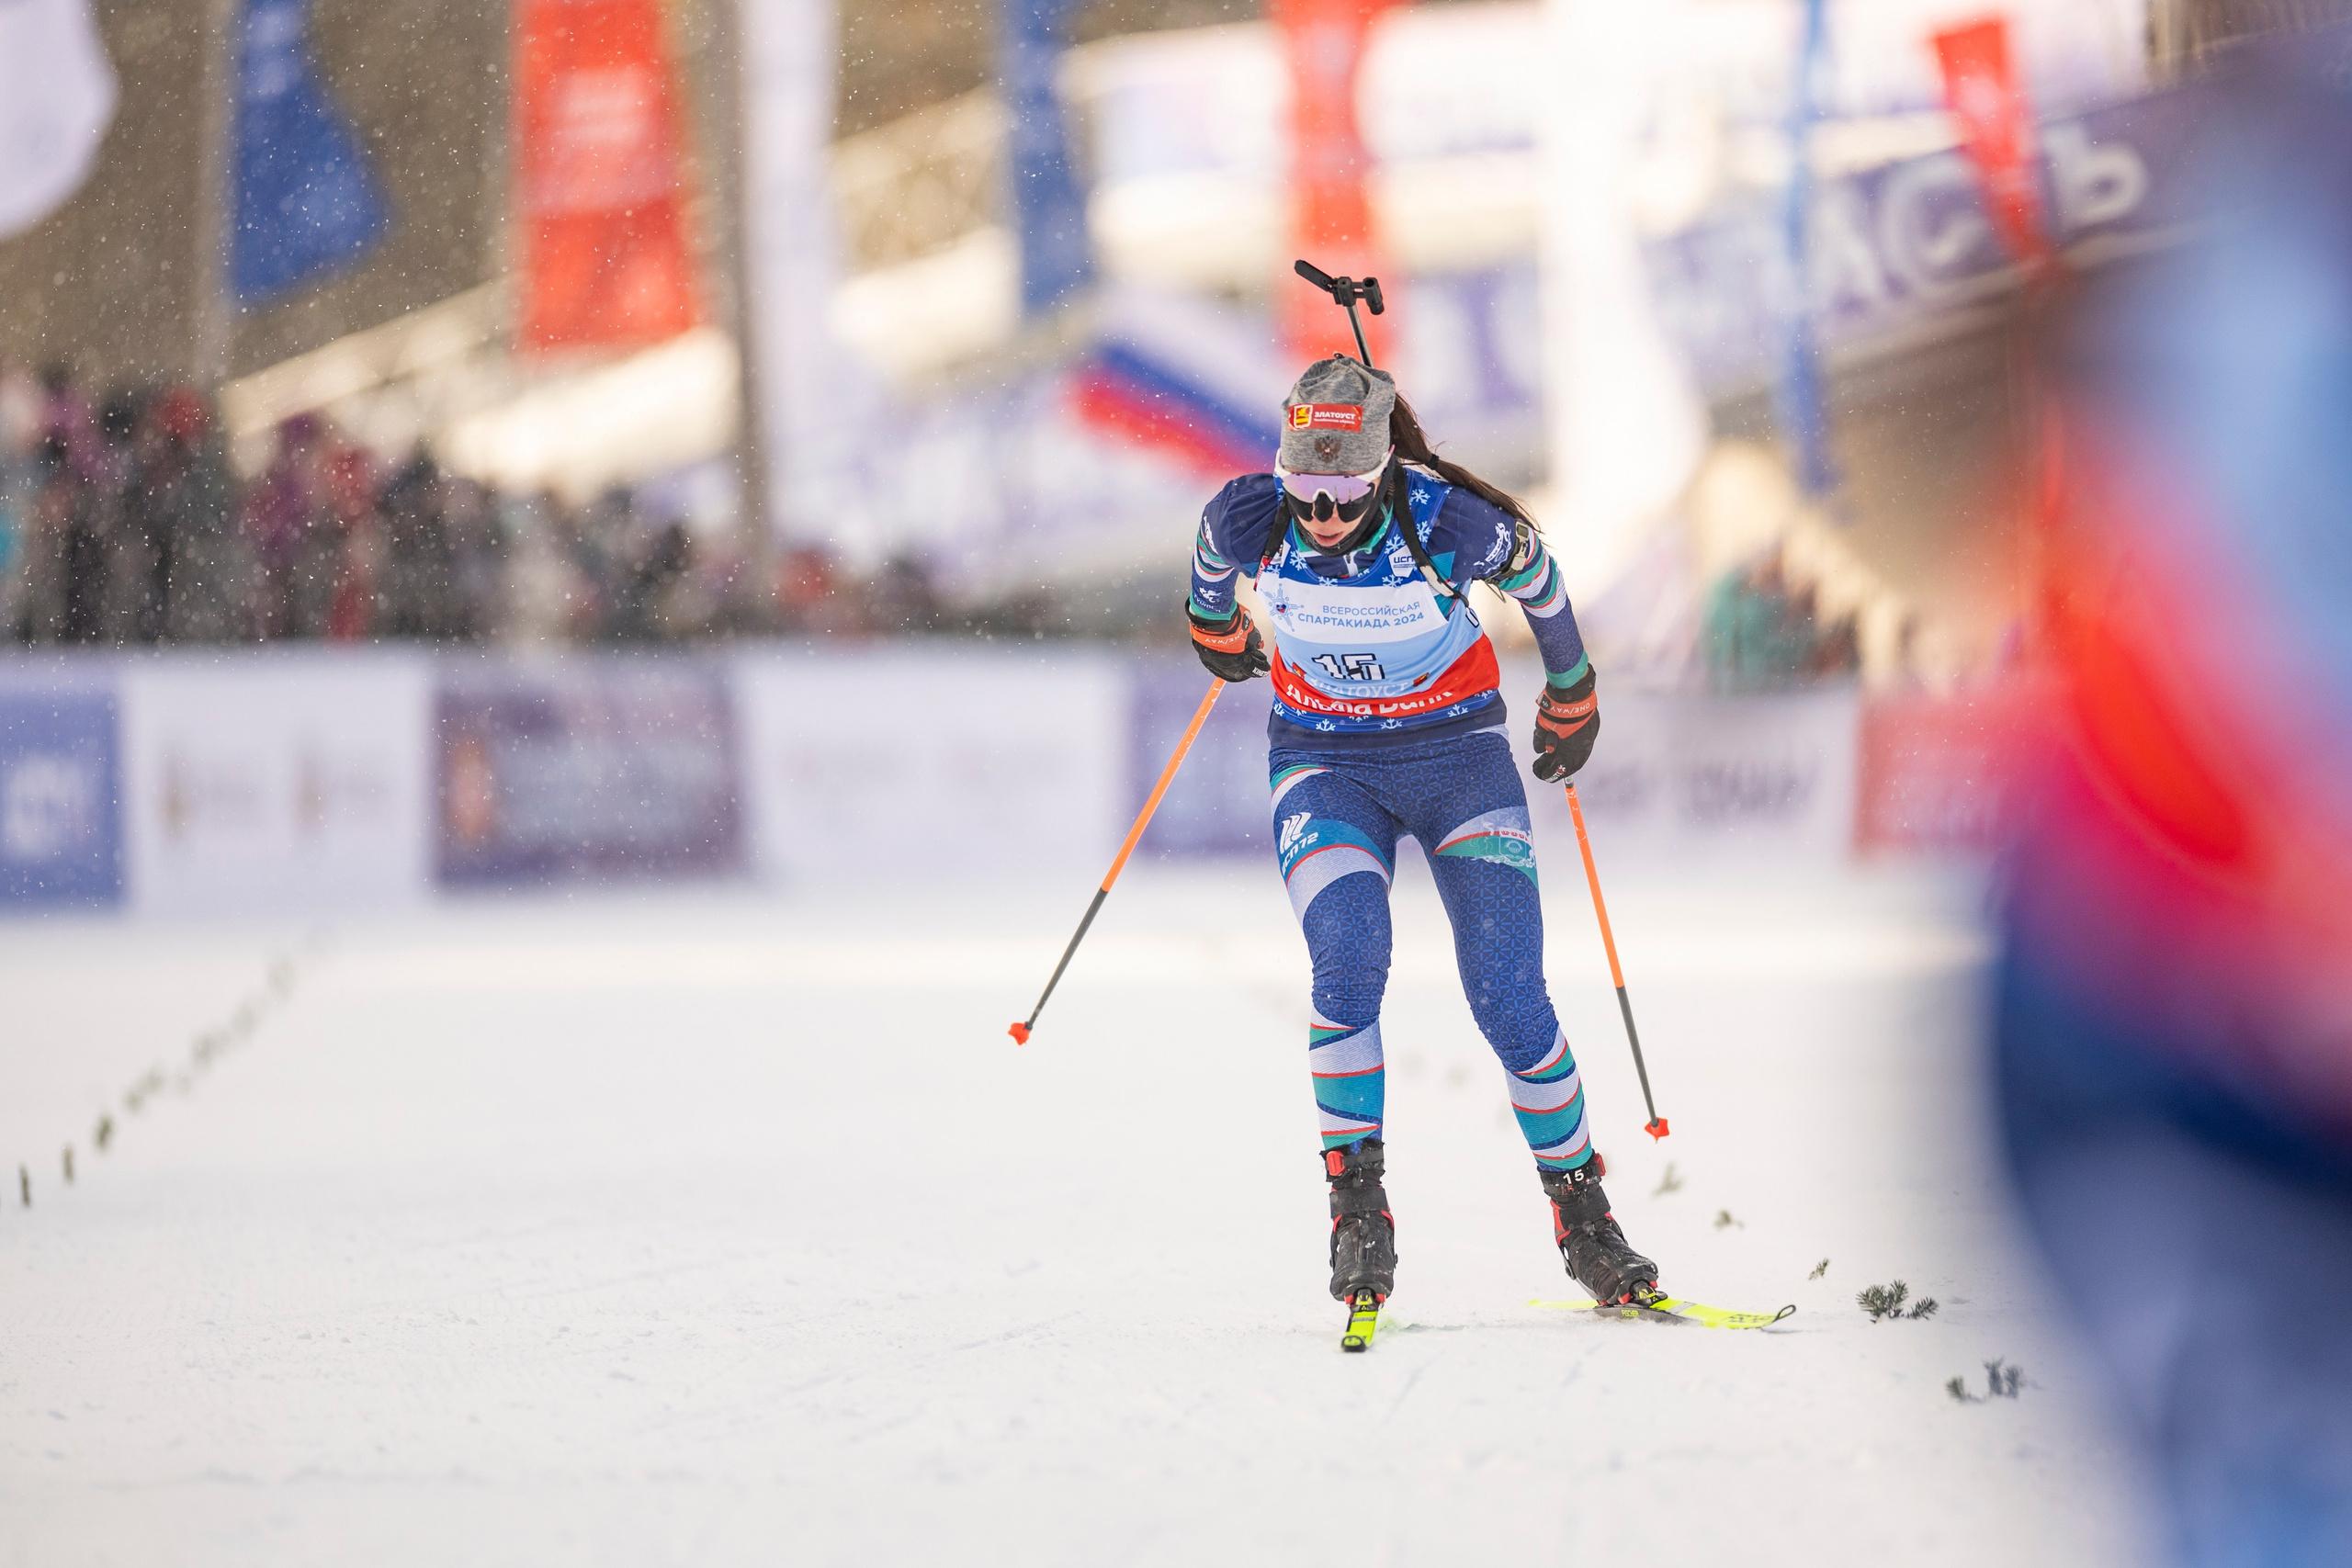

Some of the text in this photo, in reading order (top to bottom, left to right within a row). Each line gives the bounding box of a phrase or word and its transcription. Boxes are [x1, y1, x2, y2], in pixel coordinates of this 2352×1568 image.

[1315, 412, 1356, 420] ЗЛАТОУСТ
[1323, 601, 1420, 616] ВСЕРОССИЙСКАЯ
[1298, 612, 1424, 628] СПАРТАКИАДА 2024
[1311, 653, 1385, 681] 15
[1551, 702, 1590, 716] ONE/WAY
[1563, 1168, 1585, 1185] 15
